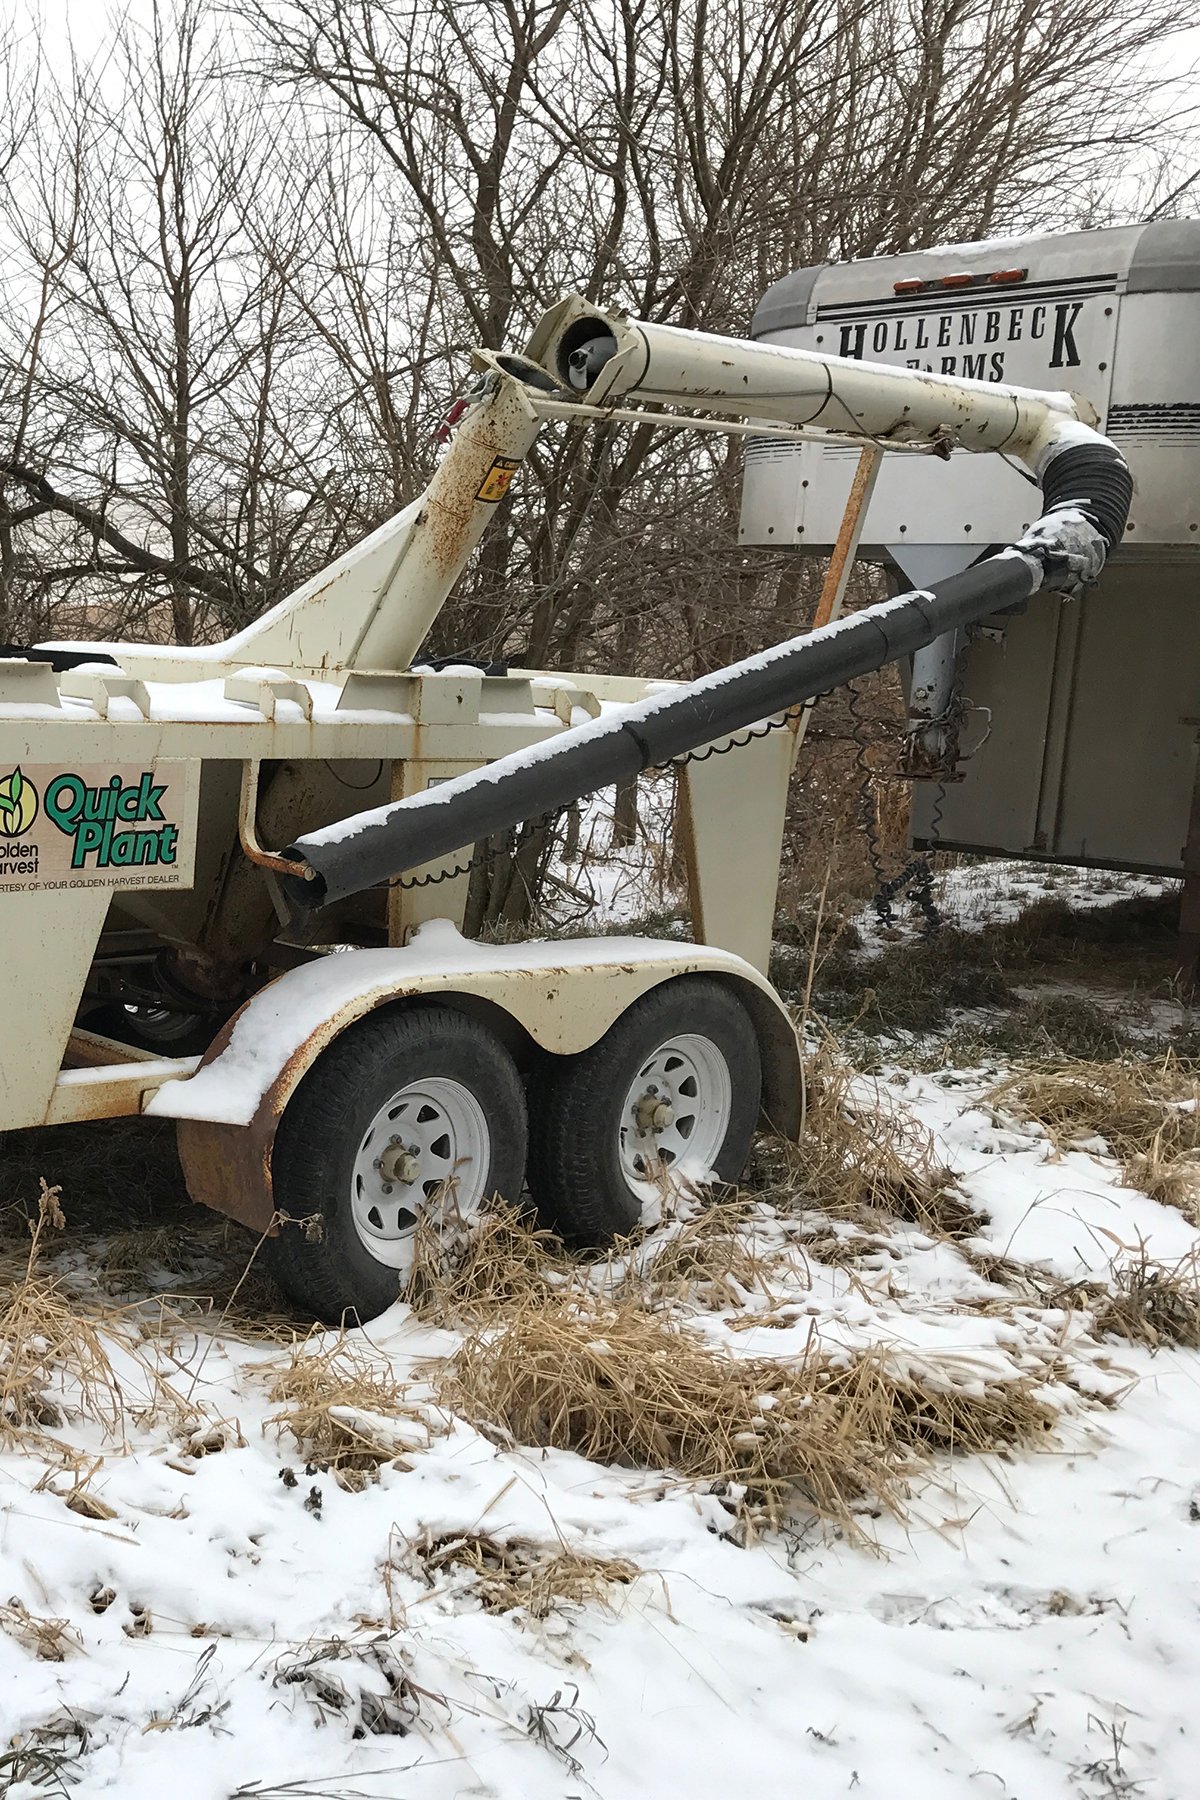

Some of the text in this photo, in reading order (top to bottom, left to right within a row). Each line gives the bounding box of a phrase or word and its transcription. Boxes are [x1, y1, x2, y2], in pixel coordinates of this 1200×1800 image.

[907, 352, 1005, 383] RMS
[44, 772, 168, 836] Quick
[70, 823, 179, 869] Plant
[28, 882, 41, 891] OF
[43, 880, 68, 890] YOUR
[69, 878, 106, 889] GOLDEN
[107, 875, 146, 887] HARVEST
[147, 874, 180, 884] DEALER
